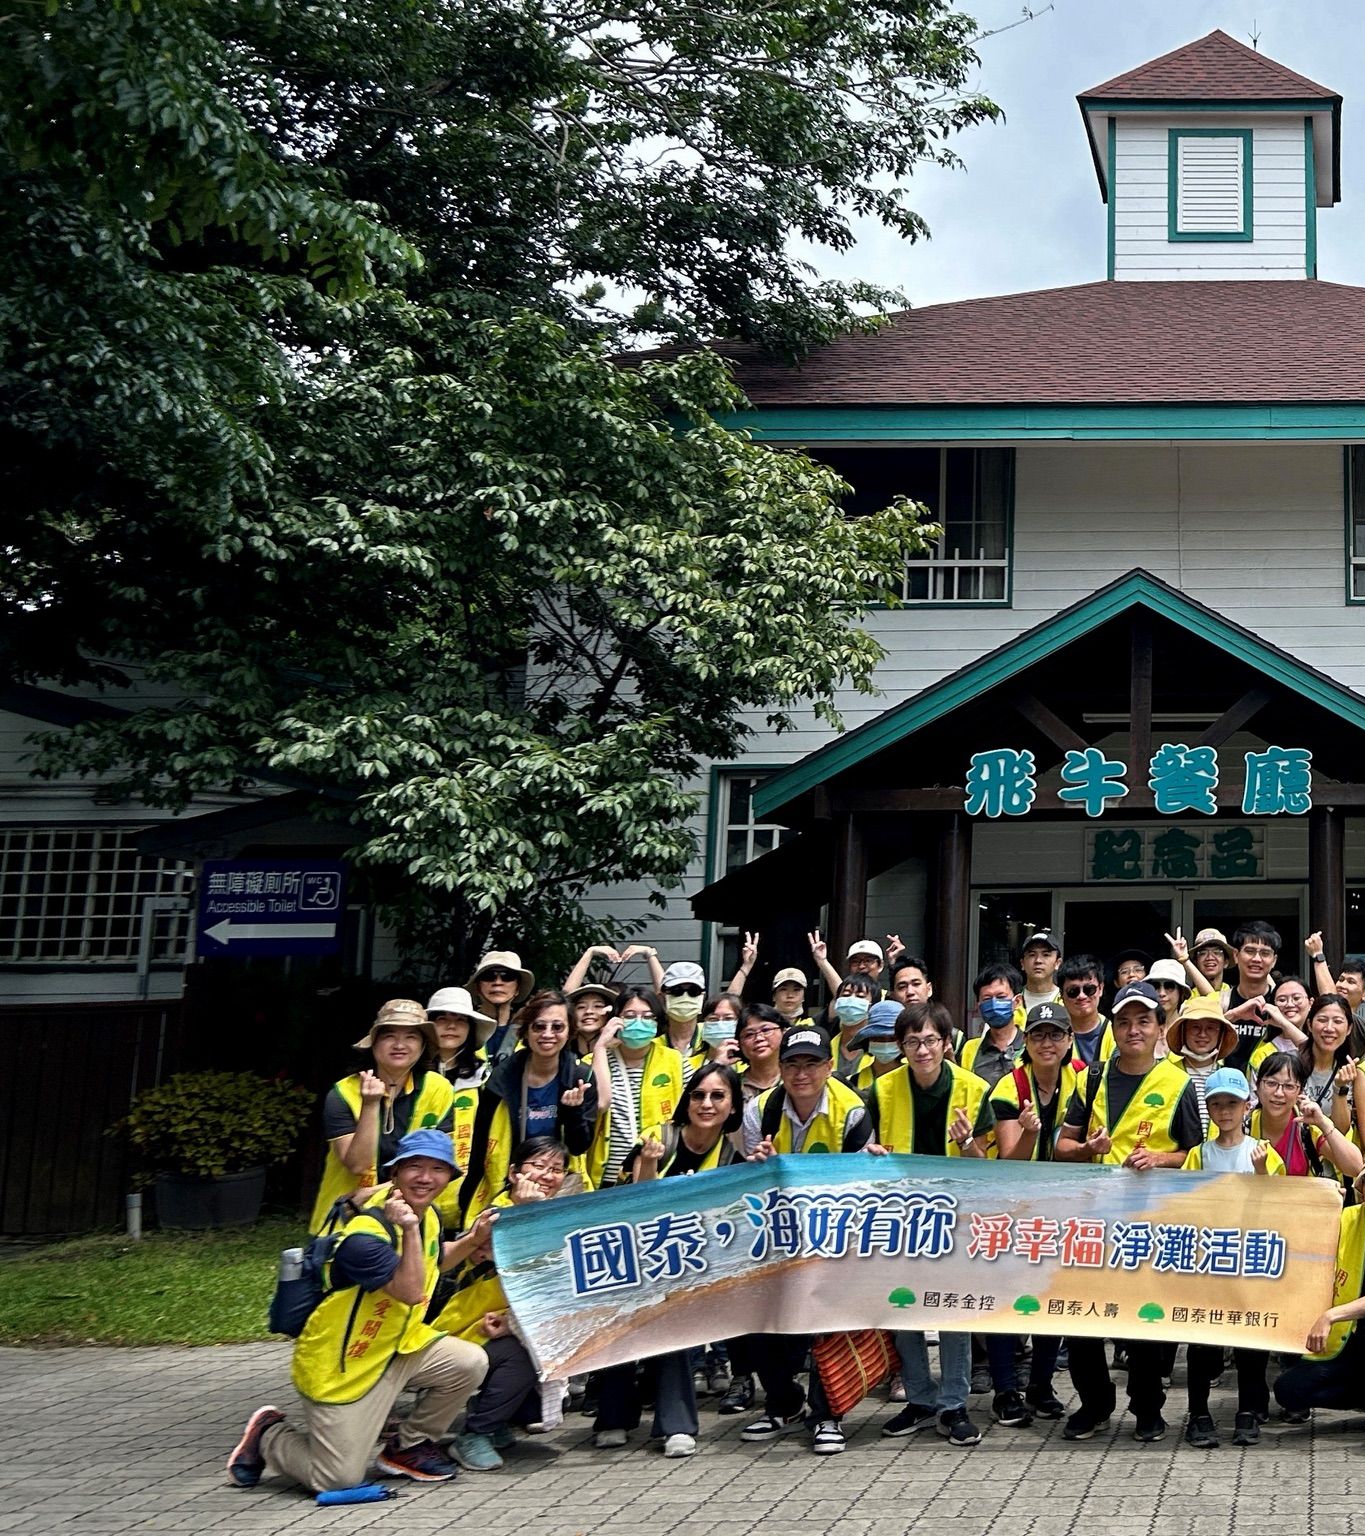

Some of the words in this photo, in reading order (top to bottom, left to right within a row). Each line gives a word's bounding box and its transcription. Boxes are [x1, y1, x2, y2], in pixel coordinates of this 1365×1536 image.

[965, 744, 1312, 818] 飛牛餐廳
[1091, 827, 1258, 880] 紀念品
[207, 871, 301, 895] 無障礙廁所
[206, 900, 265, 913] Accessible
[268, 899, 297, 912] Toilet
[923, 1291, 995, 1311] 國泰金控
[1047, 1299, 1119, 1319] 國泰人壽
[1171, 1306, 1280, 1328] 國泰世華銀行
